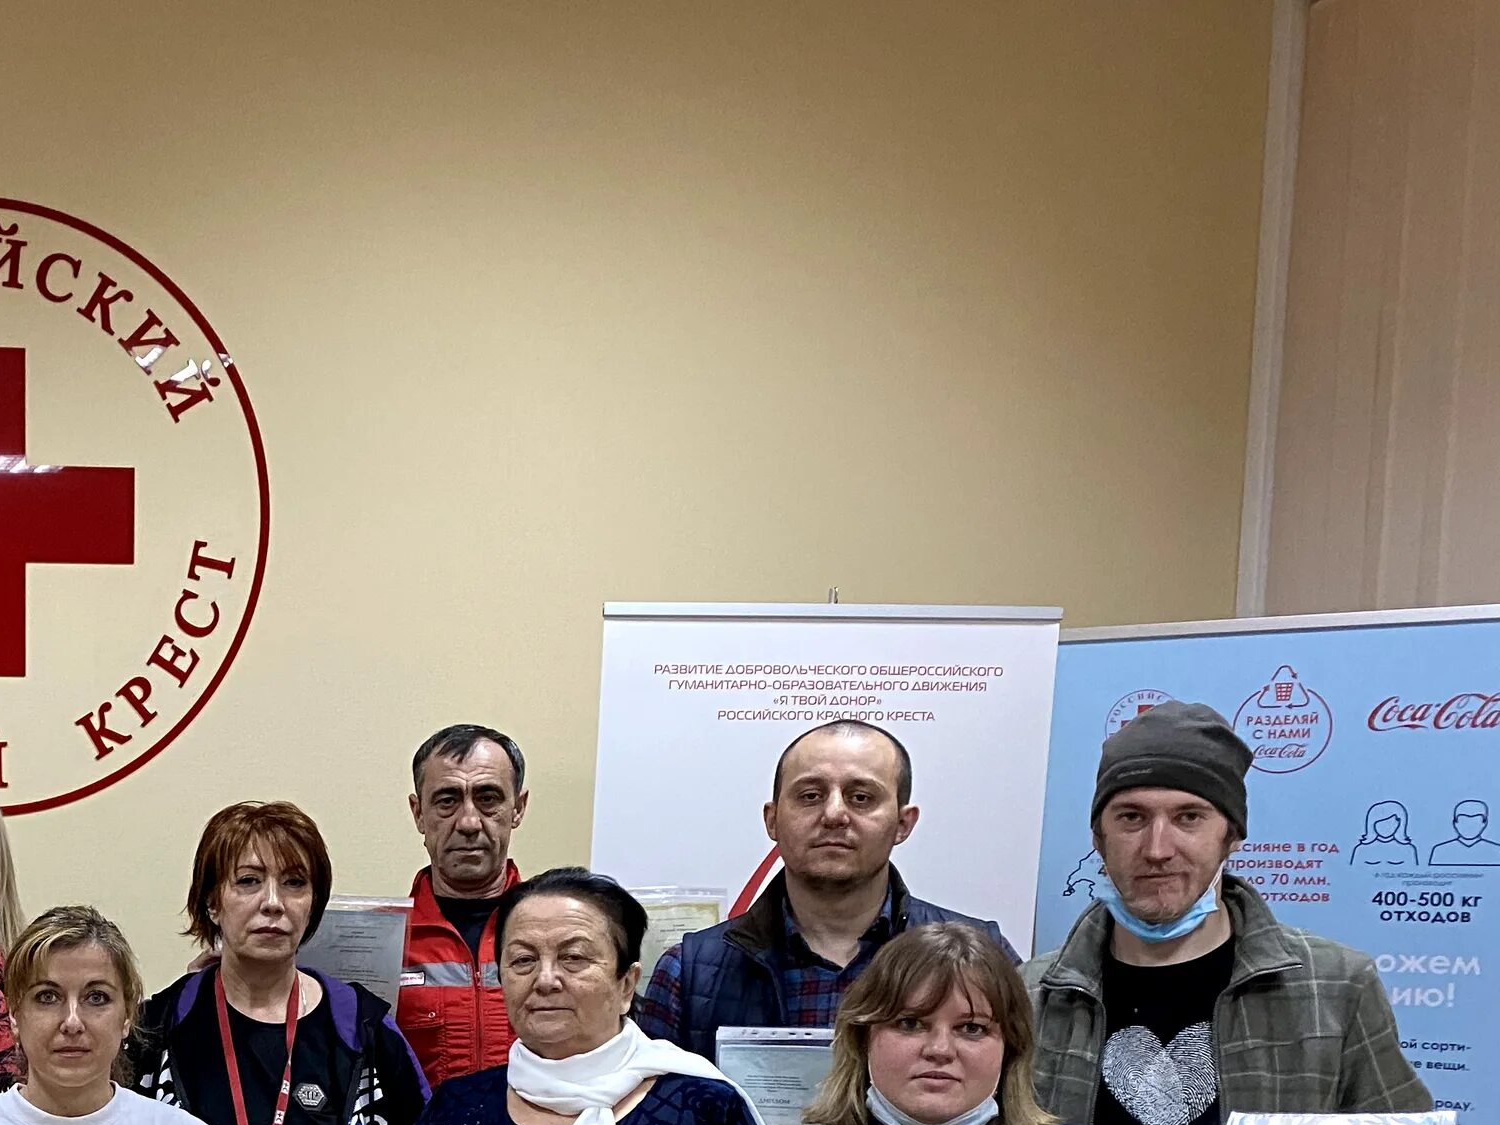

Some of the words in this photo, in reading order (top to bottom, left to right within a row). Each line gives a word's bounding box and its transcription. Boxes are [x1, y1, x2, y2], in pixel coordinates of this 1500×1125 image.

[75, 540, 237, 761] КРЕСТ
[654, 664, 723, 675] РАЗВИТИЕ
[725, 664, 868, 676] ДОБРОВОЛЬЧЕСКОГО
[869, 664, 1004, 677] ОБЩЕРОССИЙСКОГО
[668, 679, 910, 691] ГУМАНИТАРНО-ОБРАЗОВАТЕЛЬНОГО
[911, 681, 988, 692] ДВИЖЕНИЯ
[773, 696, 789, 706] «Я
[791, 693, 827, 706] ТВОЙ
[829, 695, 882, 706] ДОНОР»
[717, 708, 814, 721] РОССИЙСКОГО
[816, 710, 885, 722] КРАСНОГО
[887, 711, 936, 722] КРЕСТА
[1246, 711, 1319, 727] РАЗДЕЛЯЙ
[1252, 729, 1263, 740] С
[1267, 727, 1311, 739] НАМИ
[1237, 843, 1292, 853] сияне
[1297, 843, 1306, 852] в
[1310, 843, 1340, 854] год
[1227, 859, 1324, 871] производят
[1270, 873, 1290, 885] 70
[1293, 876, 1332, 886] млн.
[1371, 891, 1455, 907] 400-500
[1461, 896, 1483, 908] кг
[1374, 953, 1481, 976] ожем
[1390, 982, 1455, 1008] ию!
[1400, 1039, 1418, 1050] ой
[1421, 1042, 1472, 1053] сорти-
